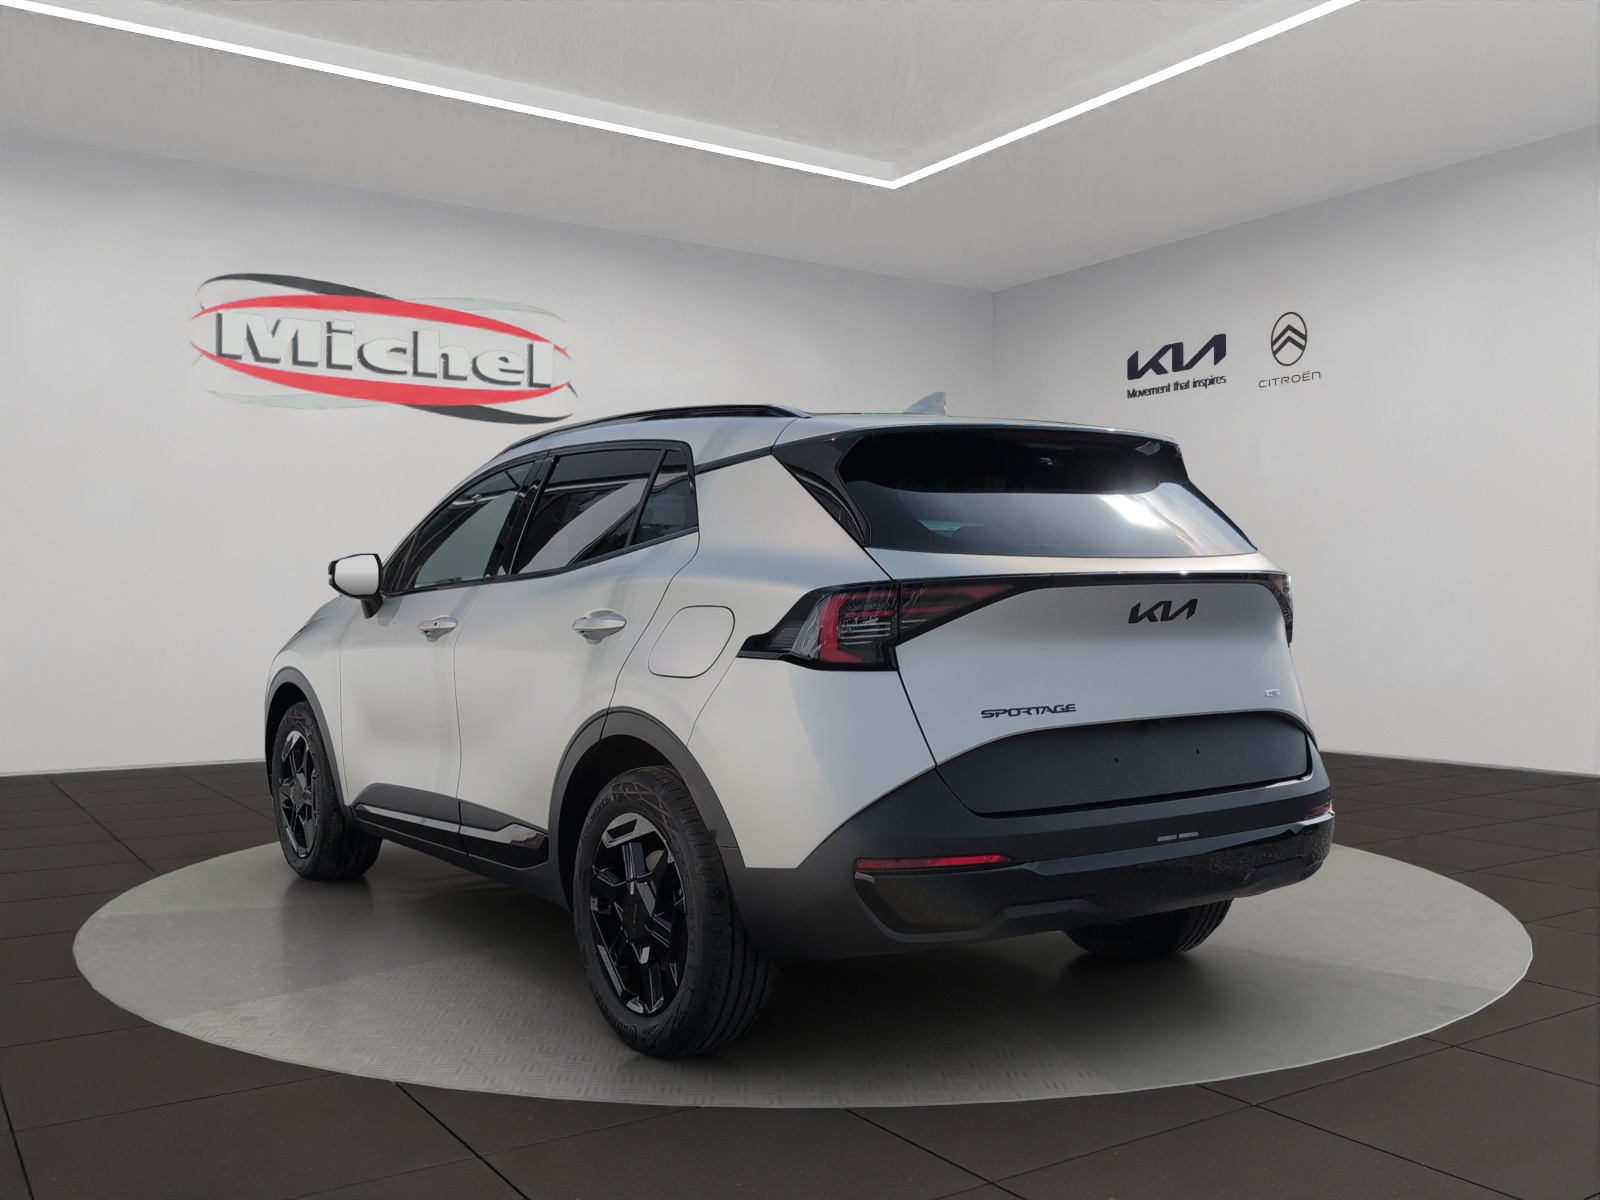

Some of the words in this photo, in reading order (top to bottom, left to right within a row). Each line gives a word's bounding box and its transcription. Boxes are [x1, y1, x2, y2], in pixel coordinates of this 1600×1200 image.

[216, 312, 555, 388] Michel
[1127, 333, 1226, 380] KIA
[1127, 382, 1171, 399] Movement
[1173, 380, 1190, 391] that
[1192, 374, 1227, 389] inspires
[1258, 371, 1321, 388] CITROËN
[1128, 598, 1198, 624] KIA
[981, 703, 1077, 718] SPORTAGE
